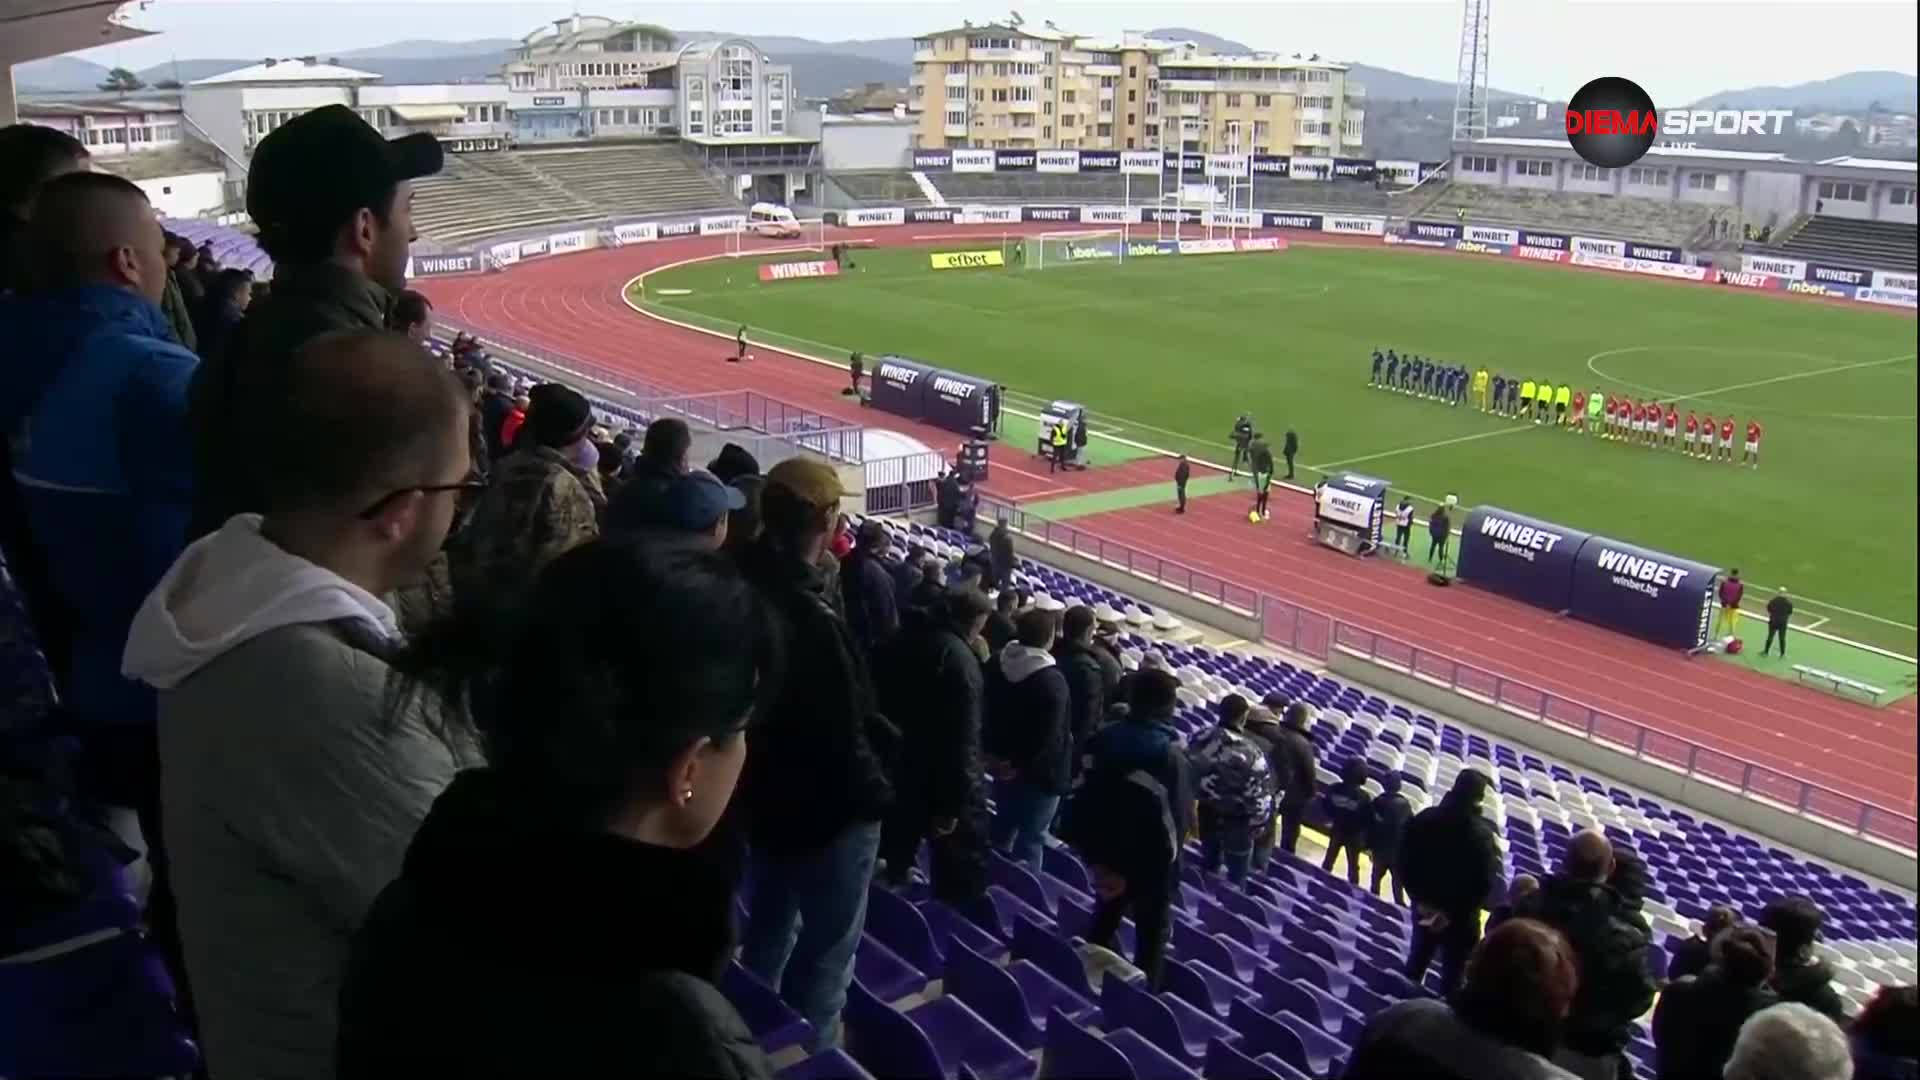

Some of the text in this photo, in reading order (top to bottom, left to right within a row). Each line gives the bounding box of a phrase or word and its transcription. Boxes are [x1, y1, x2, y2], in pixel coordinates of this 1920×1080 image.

[915, 155, 950, 166] WINBET
[955, 156, 992, 166] WINBET
[998, 156, 1034, 166] WINBET
[1040, 157, 1076, 167] WINBET
[1081, 158, 1118, 167] WINBET
[858, 212, 893, 222] WINBET
[915, 211, 951, 221] WINBET
[1032, 210, 1070, 220] WINBET
[1273, 216, 1312, 228] WINBET
[707, 220, 740, 231] WINBET
[1335, 220, 1372, 231] WINBET
[1417, 224, 1457, 239] WINBET
[1472, 229, 1510, 242] WINBET
[1526, 234, 1563, 248] WINBET
[1519, 245, 1565, 262] WINBET
[1579, 241, 1616, 255] WINBET
[1632, 246, 1673, 261] WINBET
[422, 257, 473, 272] WINBET
[948, 252, 989, 267] efbet
[1752, 259, 1796, 275] WINBET
[771, 261, 827, 279] WINBET
[1815, 267, 1863, 284] WINBET
[880, 363, 919, 385] WINBET
[933, 376, 977, 399] WINBET
[1331, 496, 1362, 512] WINBET
[1481, 515, 1562, 552] WINBET
[1493, 540, 1535, 562] winbet.bg
[1597, 548, 1689, 588] WINBET
[1612, 575, 1659, 598] winbet.bg
